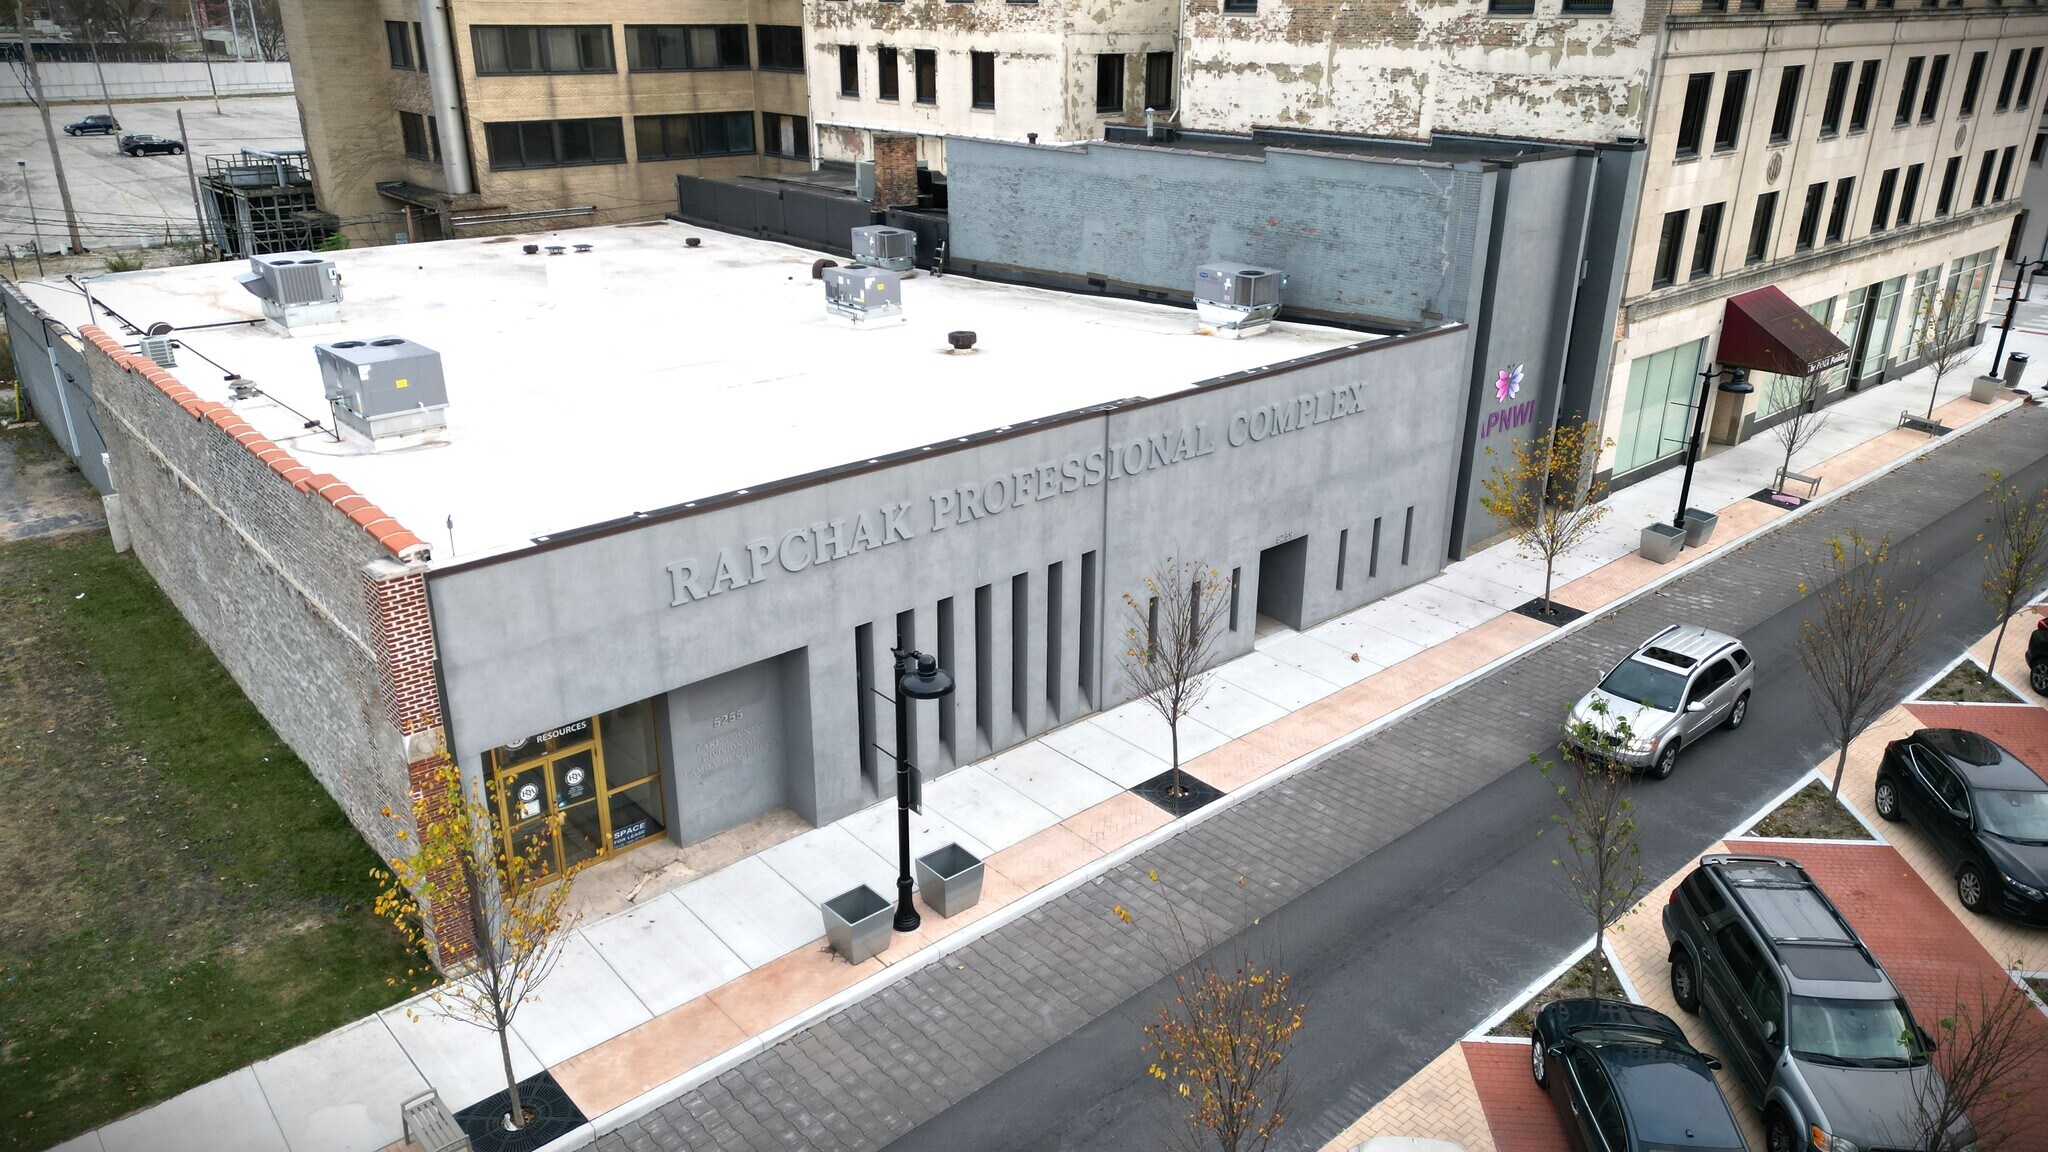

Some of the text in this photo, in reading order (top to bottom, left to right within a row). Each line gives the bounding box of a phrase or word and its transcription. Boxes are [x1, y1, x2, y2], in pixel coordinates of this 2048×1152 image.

[1830, 353, 1849, 364] Building
[666, 380, 1368, 607] RAPCHAK PROFESSIONAL COMPLEX
[712, 709, 743, 728] 5255
[536, 720, 587, 744] RESOURCES
[696, 722, 763, 754] LAKE COUNTY
[684, 740, 777, 779] FAMILY RESOURCES
[701, 736, 758, 762] DIVISION OF
[613, 821, 646, 839] SPACE
[613, 837, 627, 846] FOR
[627, 829, 646, 840] LEASE
